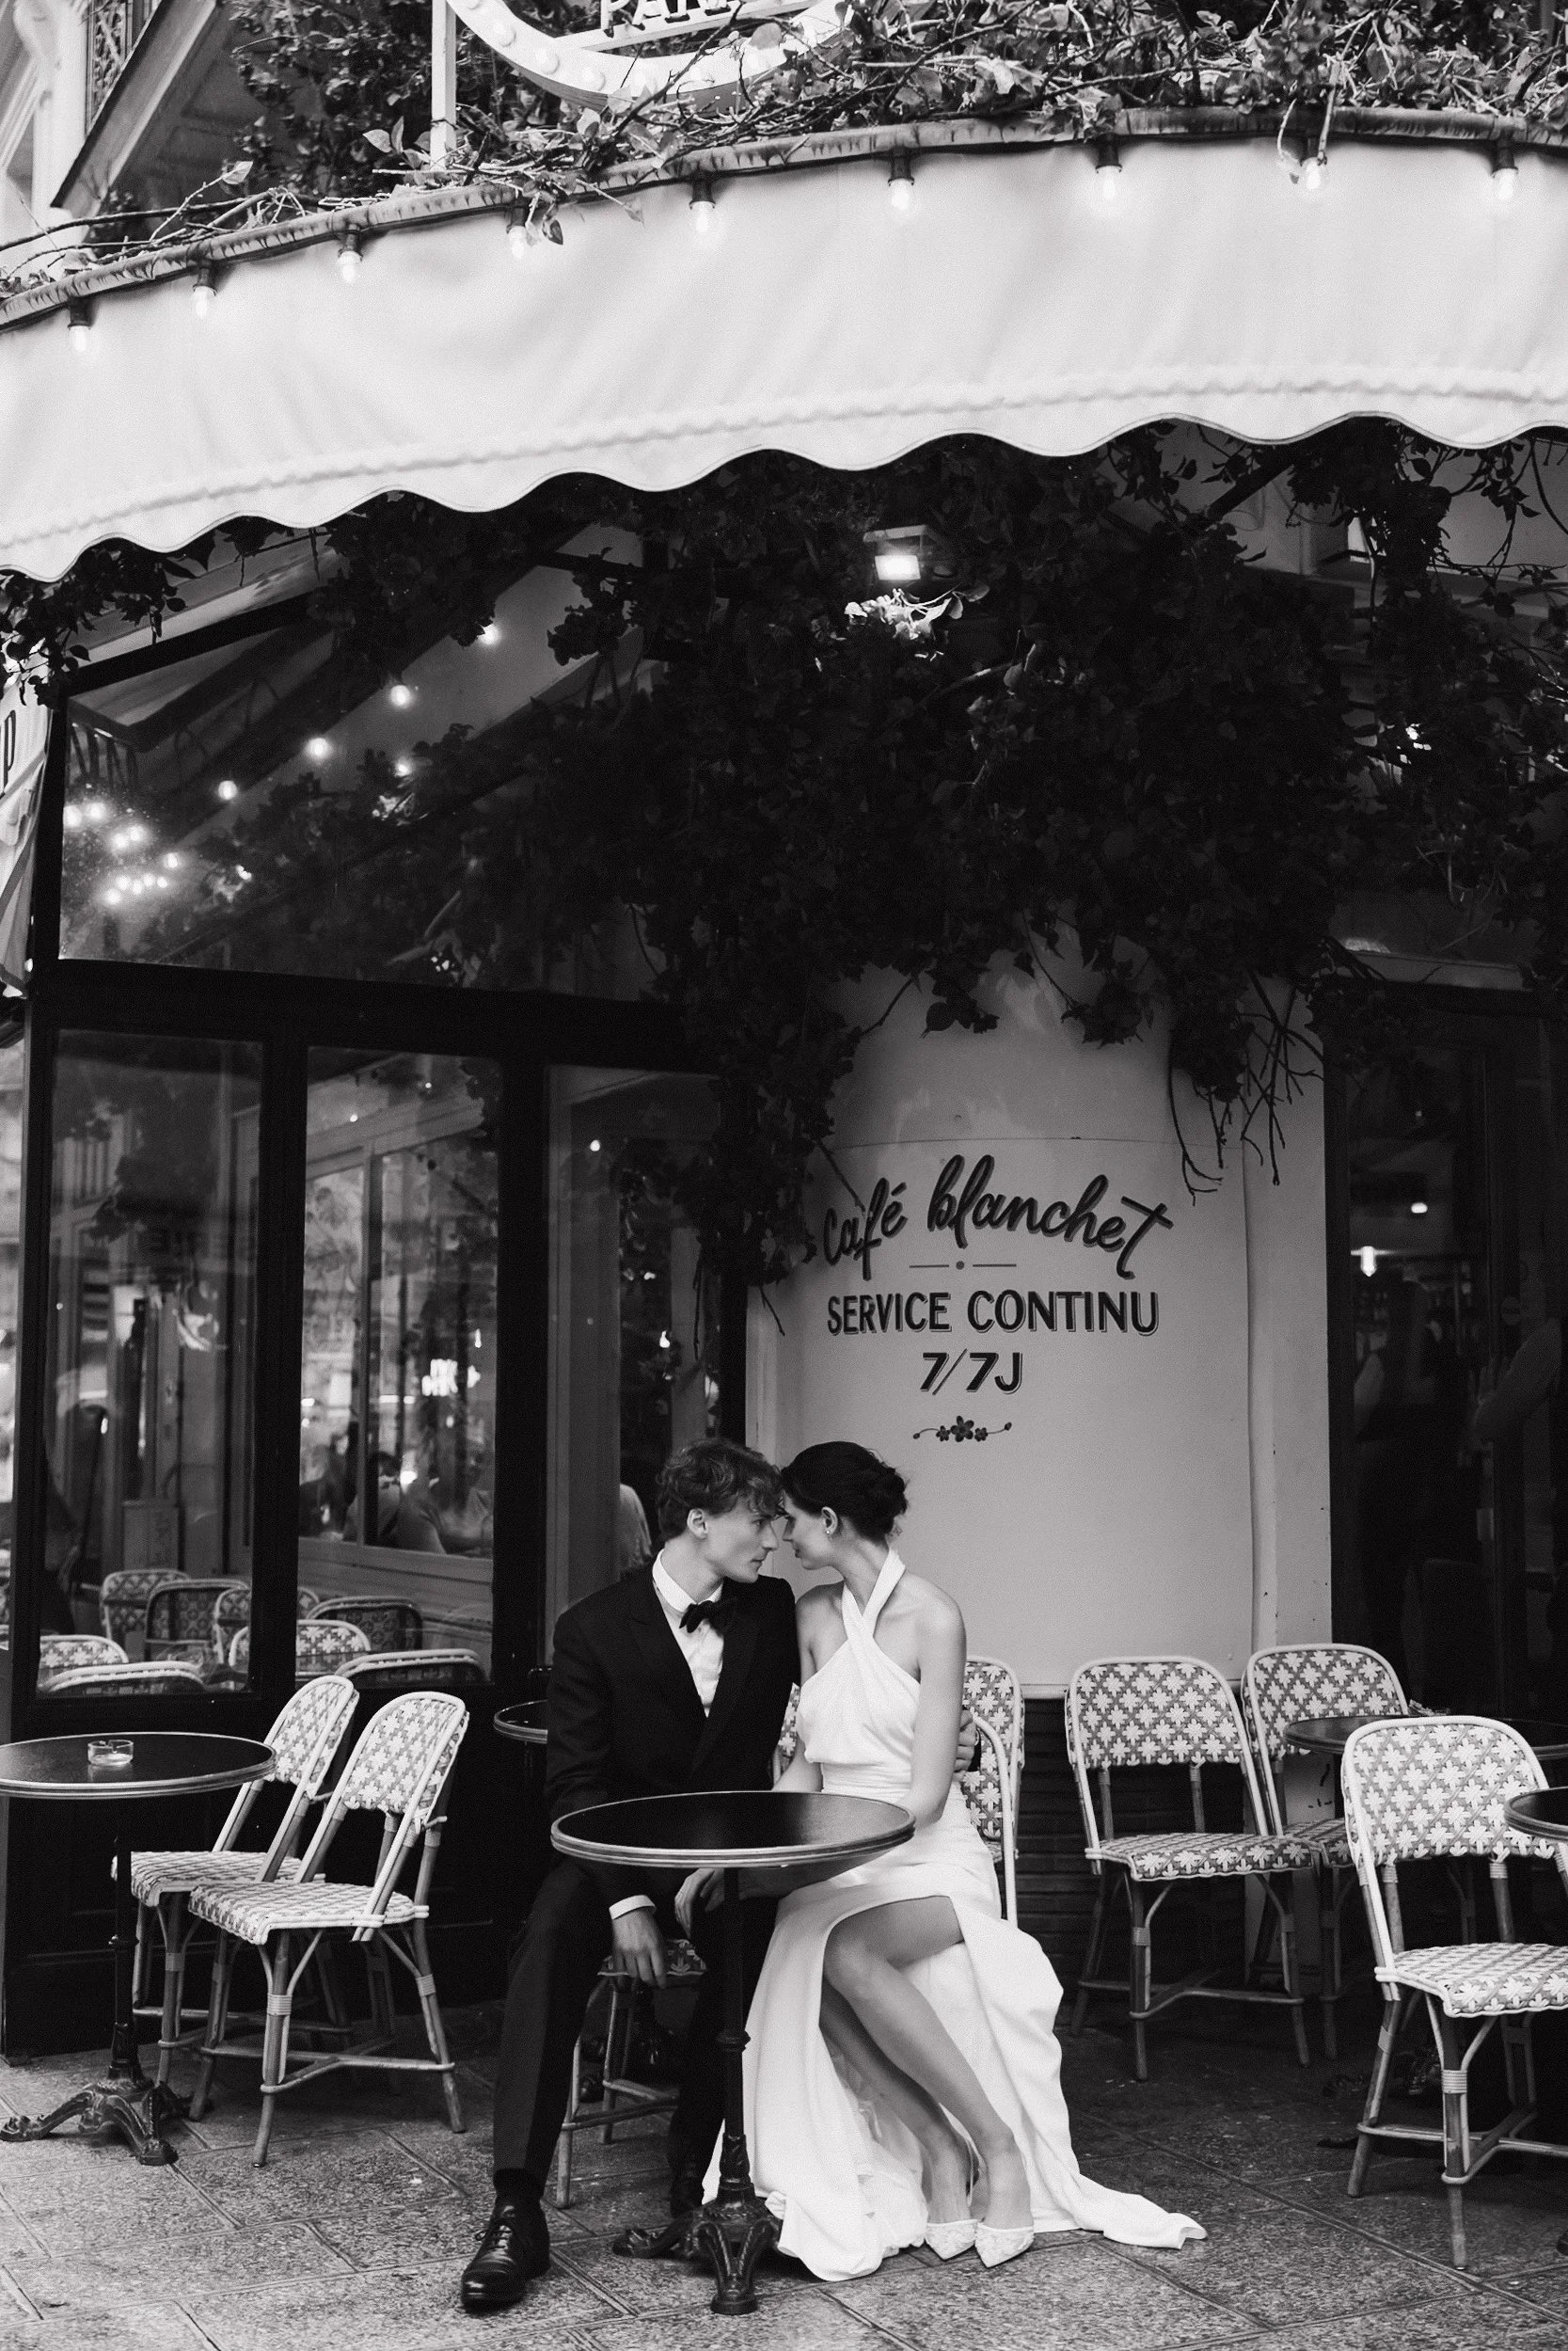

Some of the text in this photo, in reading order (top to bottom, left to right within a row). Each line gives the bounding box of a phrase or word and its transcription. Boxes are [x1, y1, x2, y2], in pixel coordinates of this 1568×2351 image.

[823, 1177, 908, 1281] Café
[827, 1289, 1160, 1337] SERVICE CONTINU
[920, 1348, 1023, 1395] 7/7J
